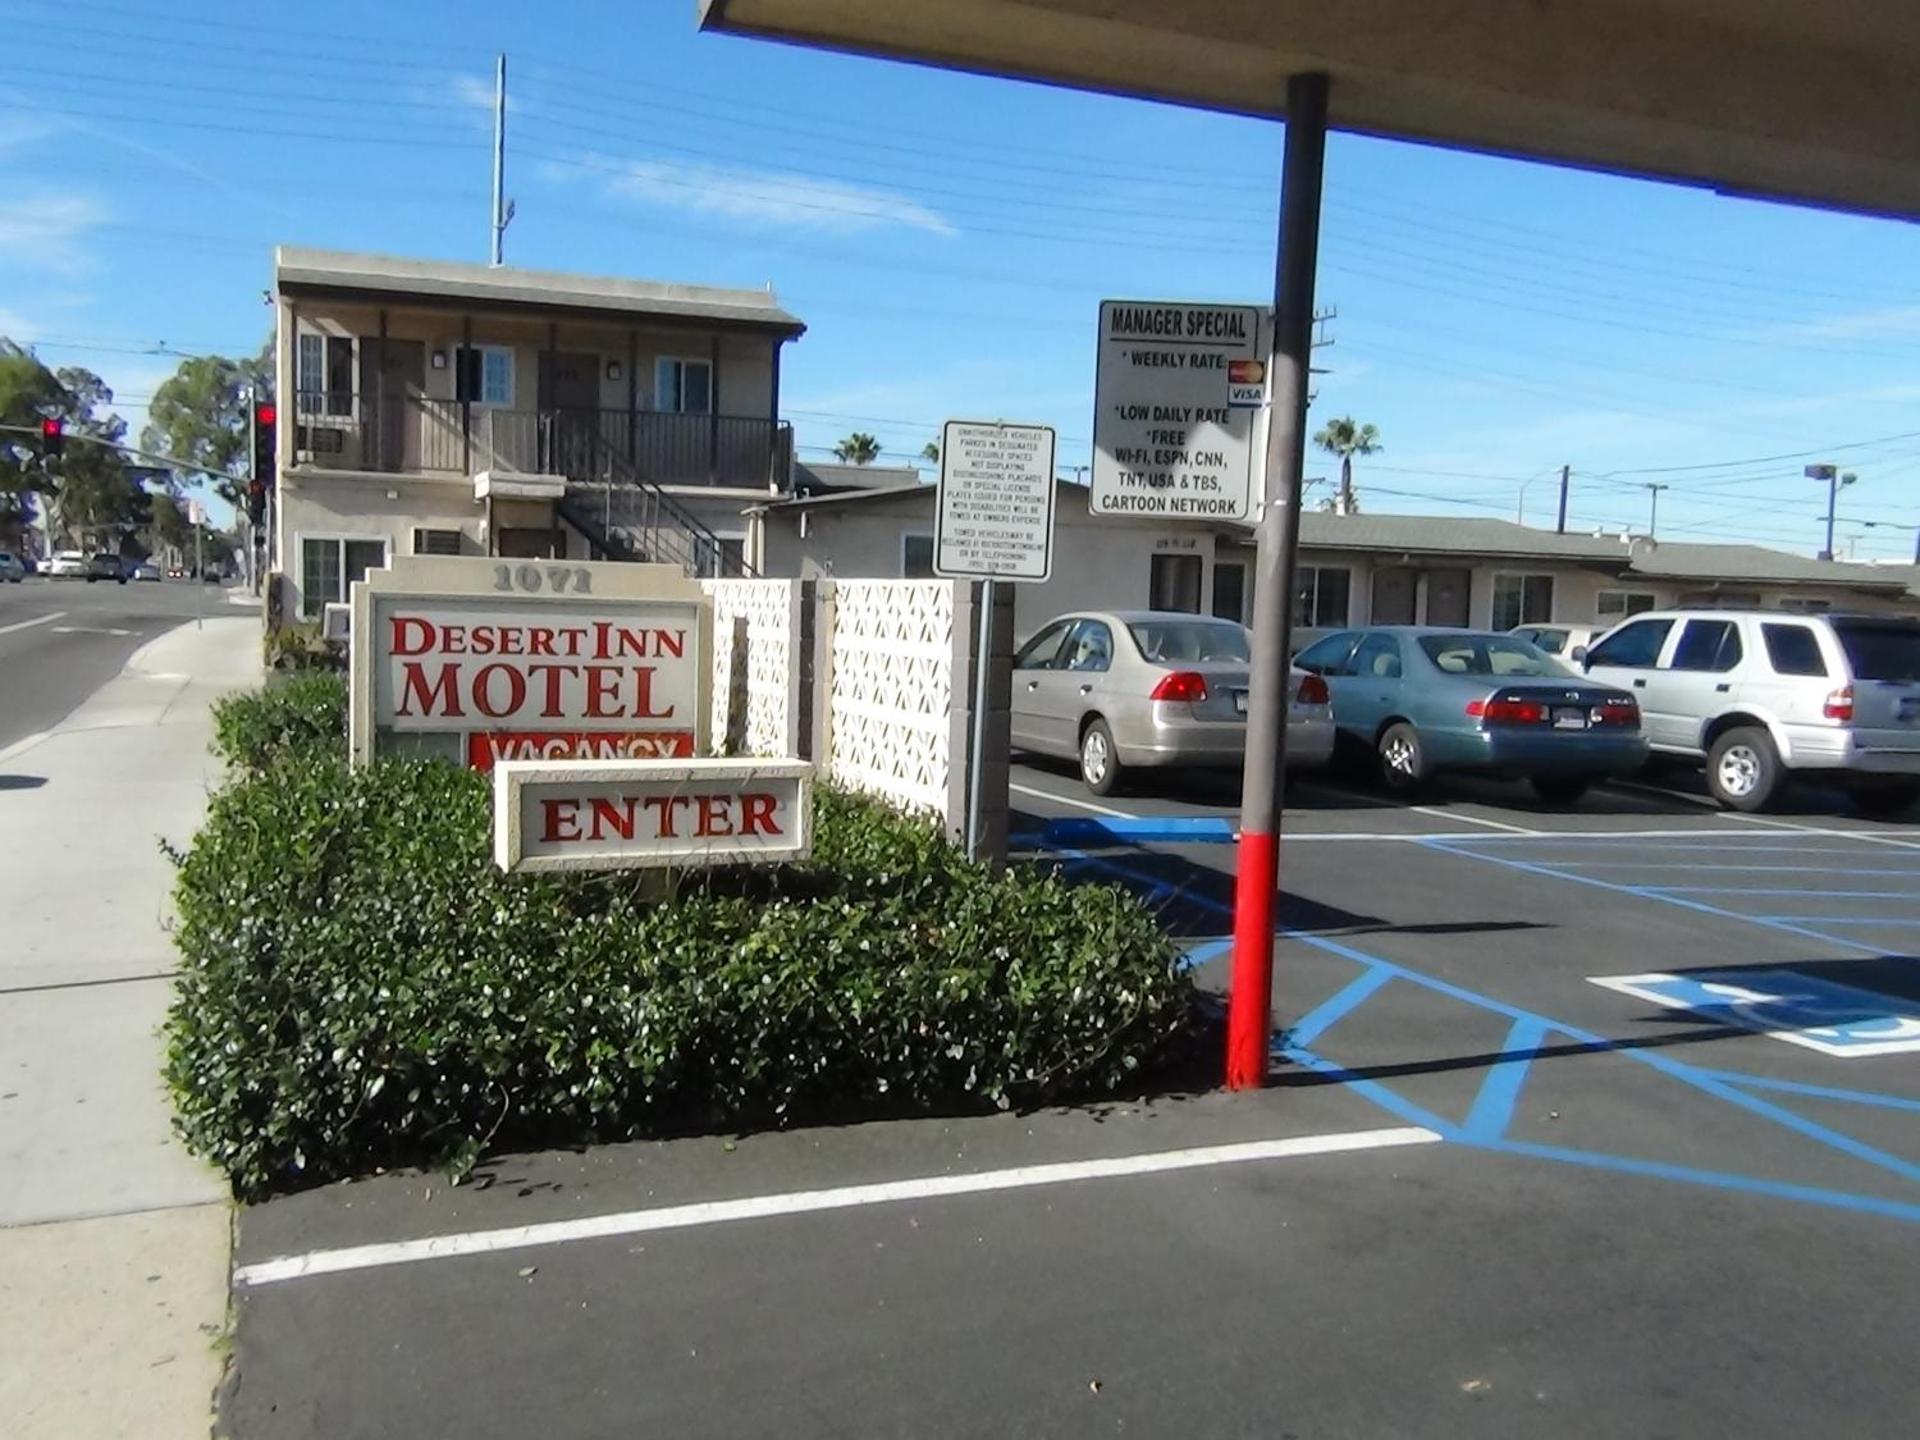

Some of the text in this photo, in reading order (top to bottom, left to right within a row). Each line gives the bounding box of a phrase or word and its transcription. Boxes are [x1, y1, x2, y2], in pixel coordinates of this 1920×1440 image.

[1112, 308, 1246, 338] MANAGER SPECIAL
[1131, 352, 1186, 369] WEEKLY
[1233, 388, 1262, 400] VISA
[1153, 406, 1191, 422] DAILY
[1196, 408, 1229, 425] RATE
[1115, 448, 1228, 471] WI-FI, ESPN, CNN,
[1118, 471, 1222, 494] TNT, USA & TBS,
[1102, 494, 1236, 514] CARTOON NETWORK
[493, 564, 593, 594] 1071
[394, 662, 676, 719] MOTEL
[540, 793, 784, 843] ENTER
